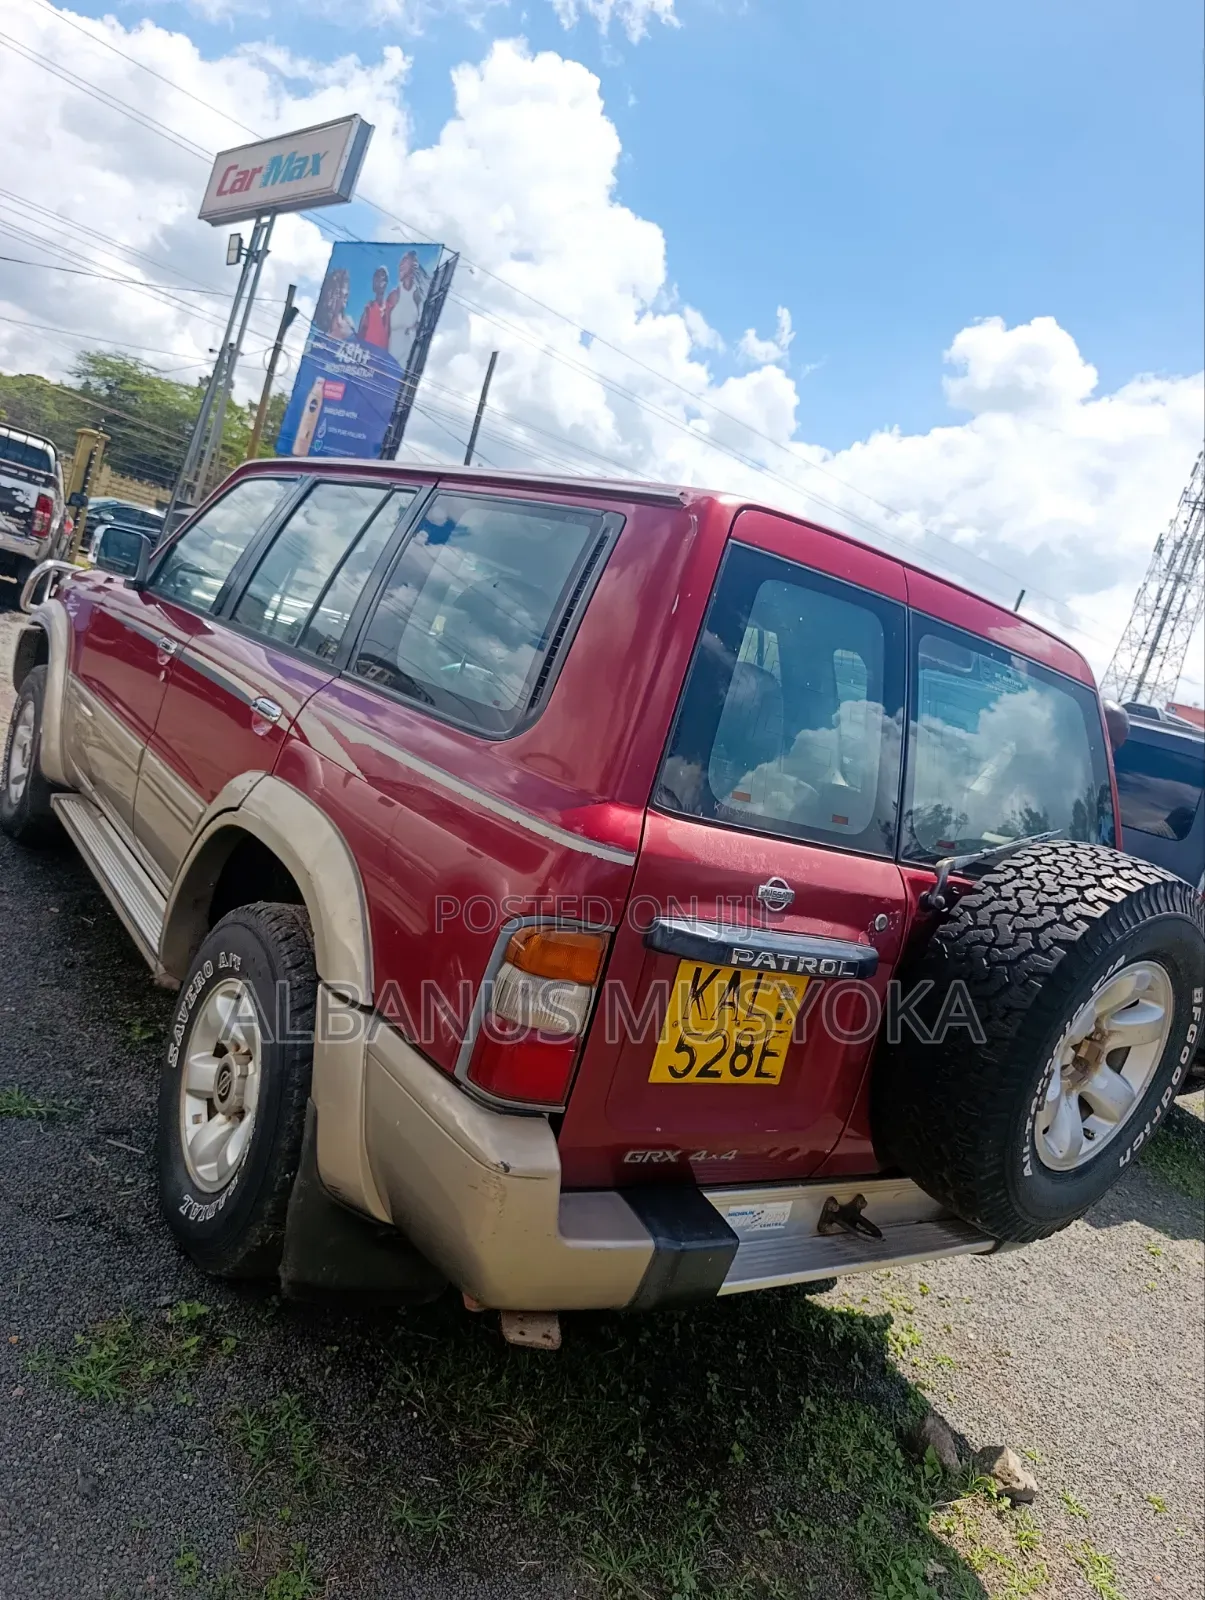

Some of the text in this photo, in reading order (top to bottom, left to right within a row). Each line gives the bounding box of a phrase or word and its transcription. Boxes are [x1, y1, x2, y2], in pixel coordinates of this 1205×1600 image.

[730, 947, 855, 977] PATROL
[167, 960, 214, 1069] SAVERO
[681, 966, 767, 1022] KAL
[667, 1026, 789, 1080] 528E
[623, 1149, 682, 1163] GRX
